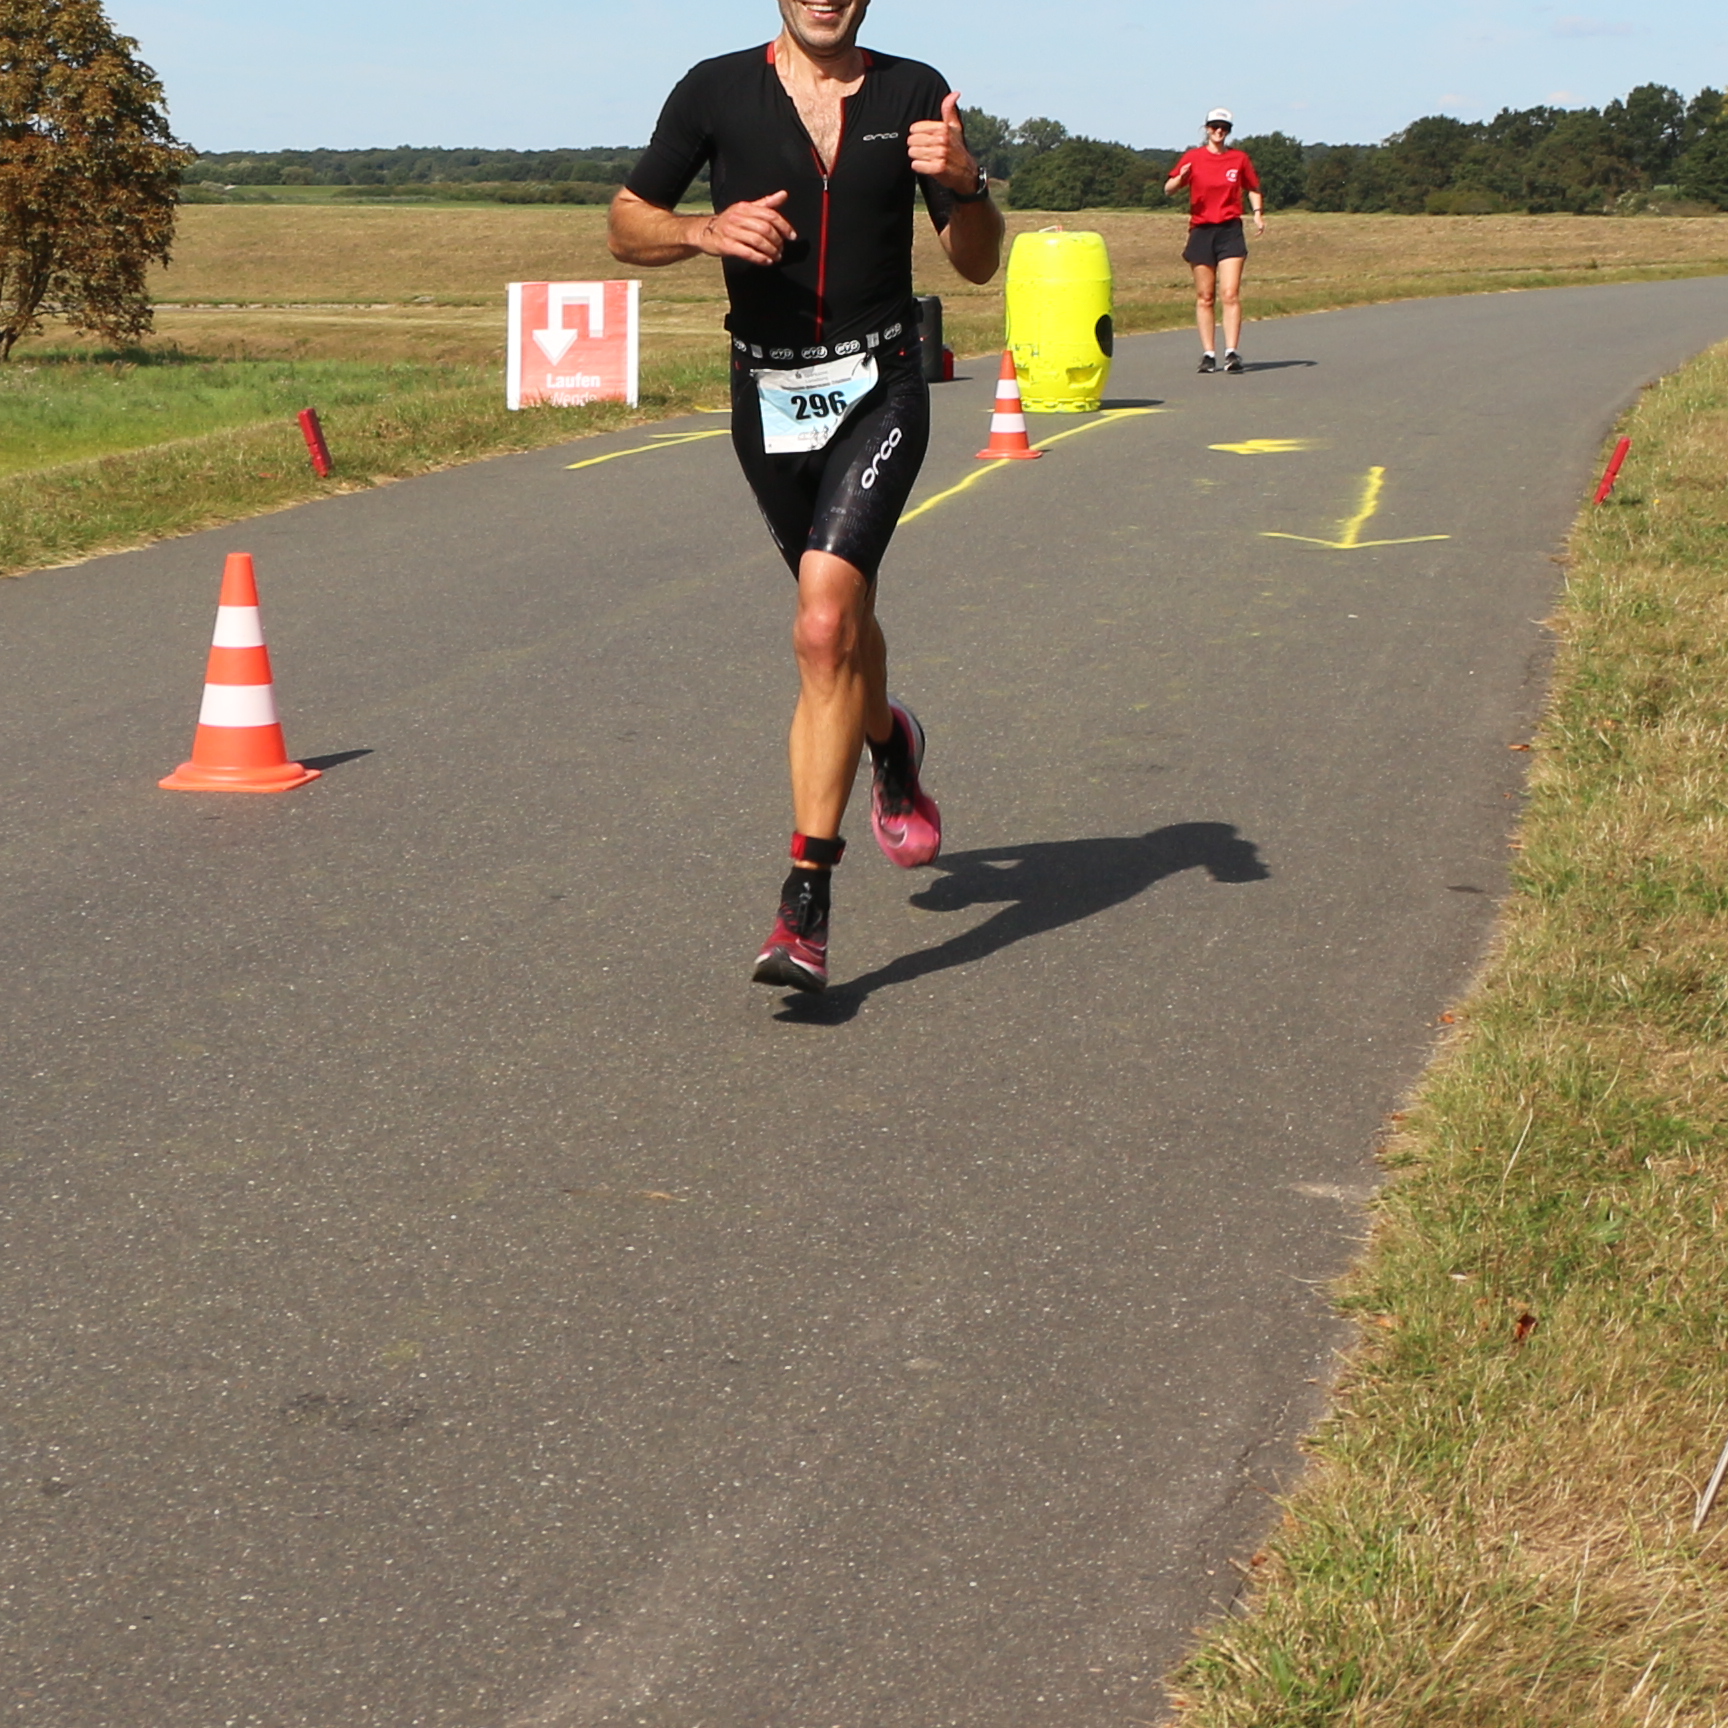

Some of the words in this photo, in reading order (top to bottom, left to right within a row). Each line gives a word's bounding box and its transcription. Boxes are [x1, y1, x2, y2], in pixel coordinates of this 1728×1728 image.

[862, 132, 899, 142] orca
[545, 371, 601, 389] Laufen
[790, 390, 848, 421] 296
[860, 426, 903, 490] orca
